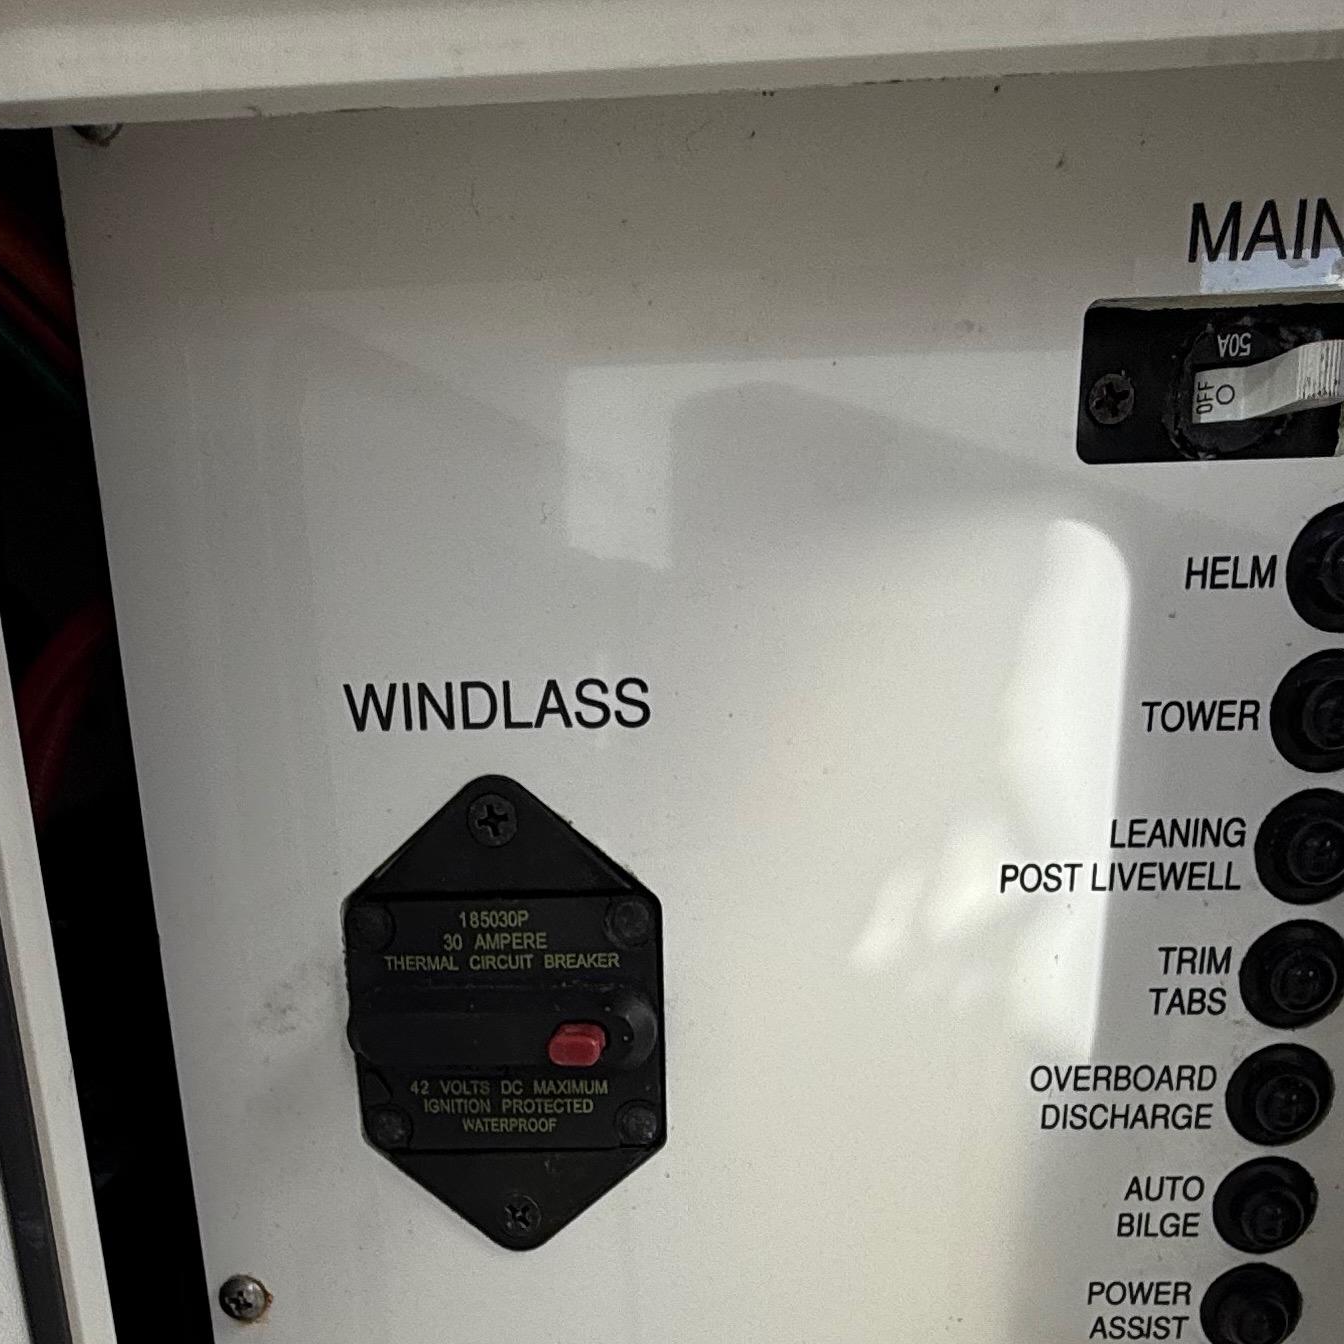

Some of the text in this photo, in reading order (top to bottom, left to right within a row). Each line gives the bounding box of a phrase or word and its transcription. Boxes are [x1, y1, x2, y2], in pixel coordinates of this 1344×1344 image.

[1216, 332, 1252, 358] 50A
[1195, 380, 1216, 415] OFF
[1184, 554, 1278, 590] HELM
[342, 676, 652, 733] WINDLASS
[1140, 699, 1261, 733] TOWER
[1109, 816, 1247, 850] LEANING
[999, 860, 1242, 894] POST LIVEWELL
[458, 909, 530, 929] 185030P
[442, 931, 548, 951] 30 AMPERE
[383, 951, 620, 971] THERMAL CIRCUIT BREAKER
[1157, 945, 1233, 976] TRIM
[1148, 986, 1227, 1017] TABS
[409, 1079, 609, 1096] 42 VOLTS DC MAXIMUM
[1029, 1064, 1218, 1093] OVERBOARD
[424, 1097, 594, 1114] IGNITION PROTECTED
[1039, 1102, 1214, 1131] DISCHARGE
[462, 1116, 558, 1133] WATERPROOF
[1123, 1175, 1206, 1202] AUTO
[1116, 1211, 1201, 1238] BILGE
[1086, 1280, 1192, 1306] POWER
[1088, 1315, 1190, 1340] ASSIST
